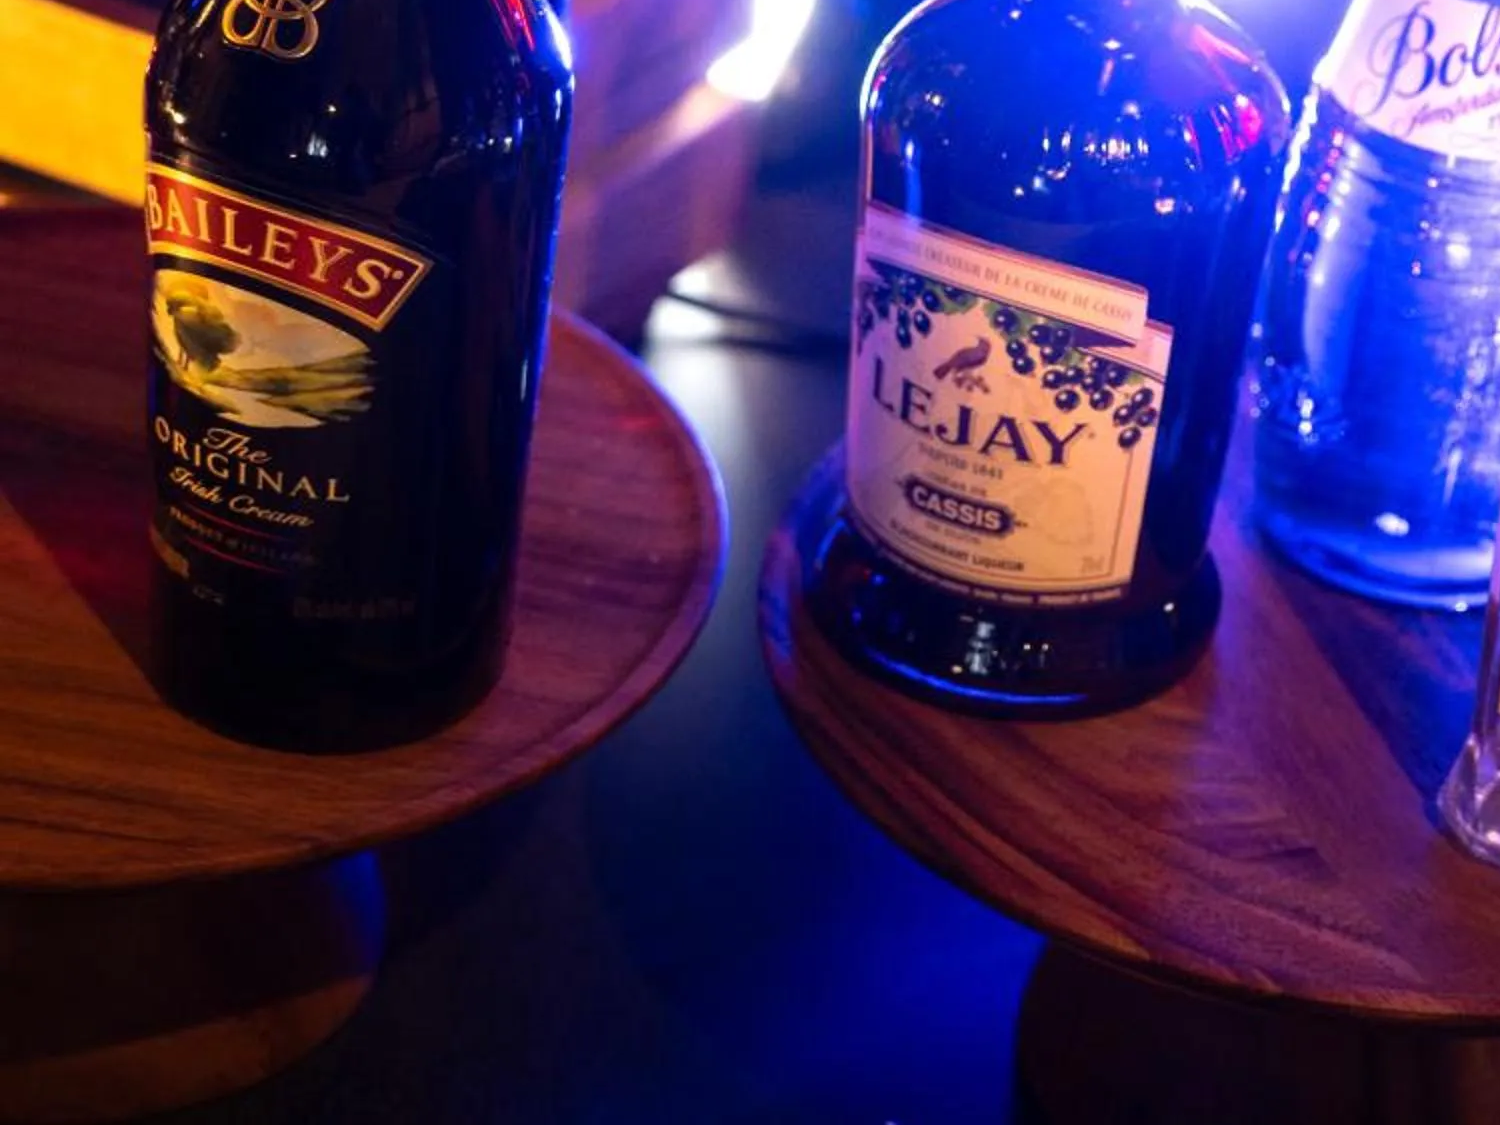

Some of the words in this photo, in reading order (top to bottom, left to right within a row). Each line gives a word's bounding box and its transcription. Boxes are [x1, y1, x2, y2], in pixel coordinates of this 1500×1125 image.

[148, 183, 393, 300] BAILEYS
[203, 427, 272, 464] The
[871, 357, 1088, 466] LEJAY
[154, 415, 350, 503] ORIGINAL
[168, 466, 224, 504] Irish
[229, 494, 315, 527] Cream
[911, 484, 1001, 531] CASSIS
